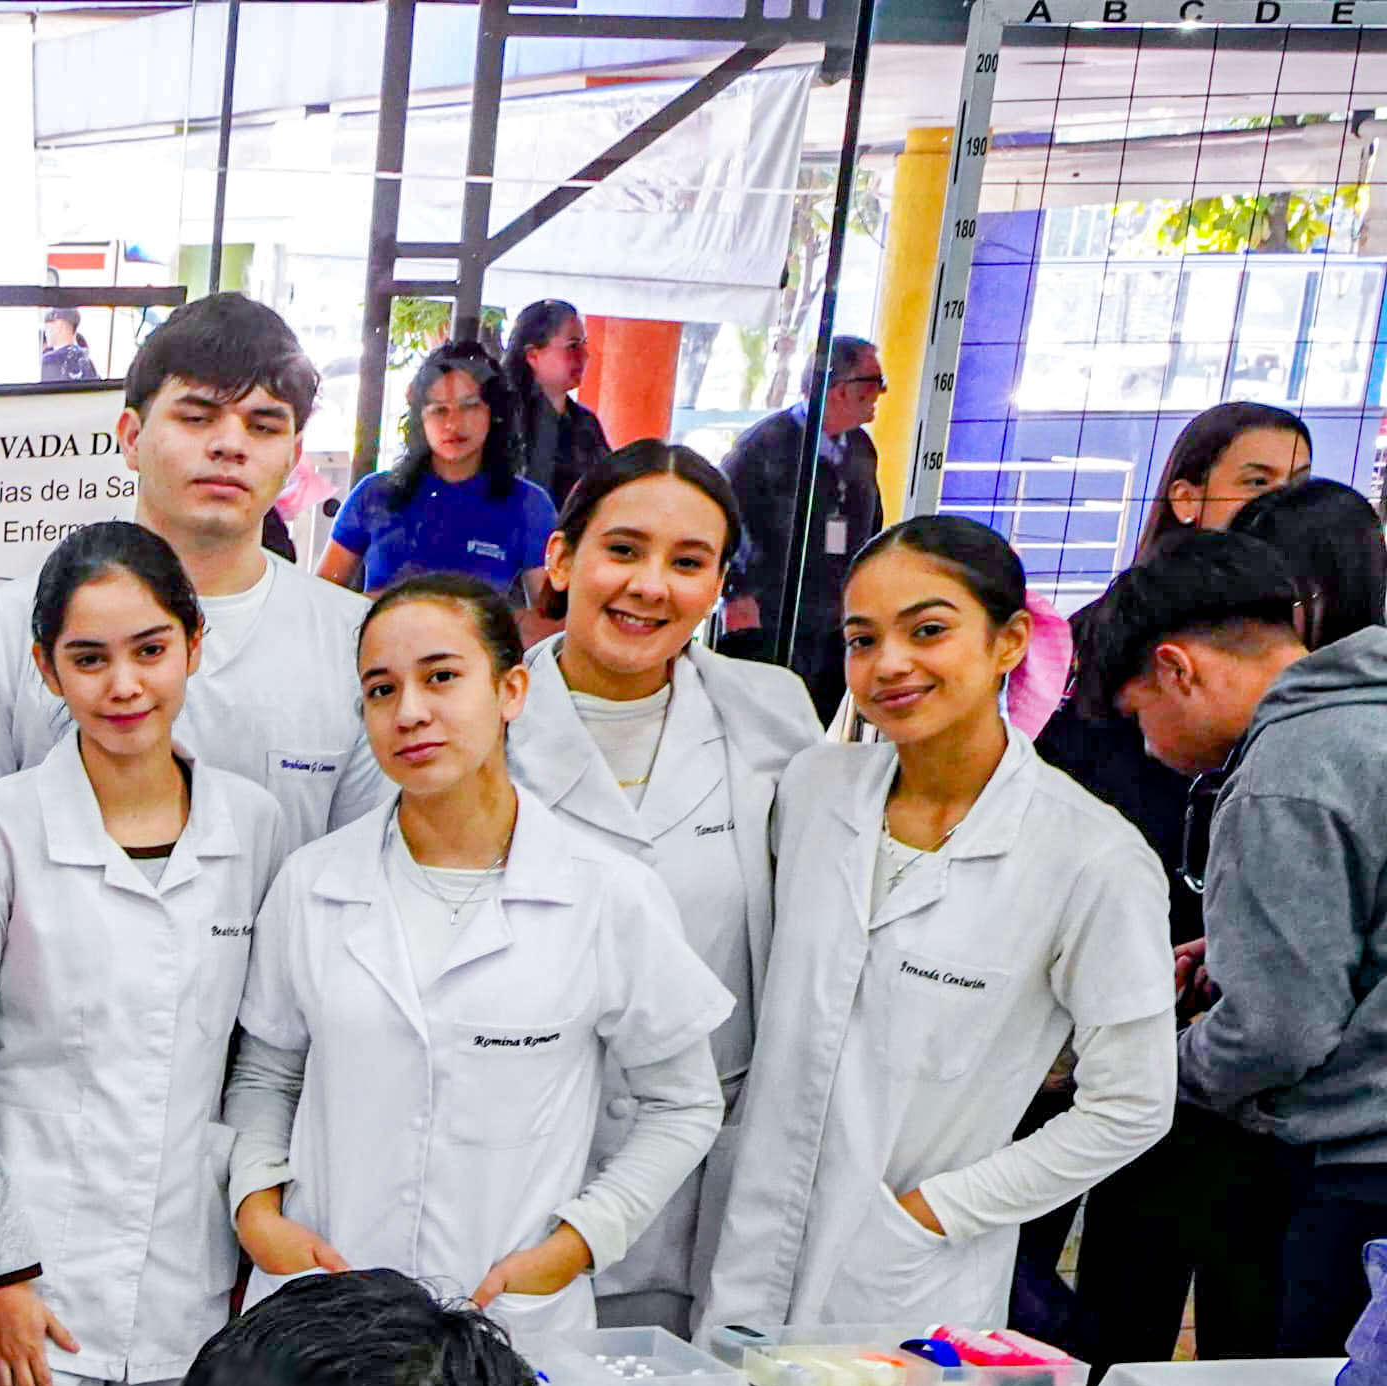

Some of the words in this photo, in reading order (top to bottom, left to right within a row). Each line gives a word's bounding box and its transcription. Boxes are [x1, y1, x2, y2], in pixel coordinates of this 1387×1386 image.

[1025, 1, 1053, 23] A
[1102, 0, 1129, 22] B
[1178, 0, 1206, 22] C
[1255, 0, 1283, 23] D
[1330, 0, 1357, 24] E
[975, 53, 999, 74] 200
[965, 136, 988, 157] 190
[954, 218, 977, 239] 180
[942, 300, 964, 321] 170
[932, 372, 954, 393] 160
[921, 451, 944, 471] 150
[40, 477, 70, 502] de
[78, 476, 98, 500] la
